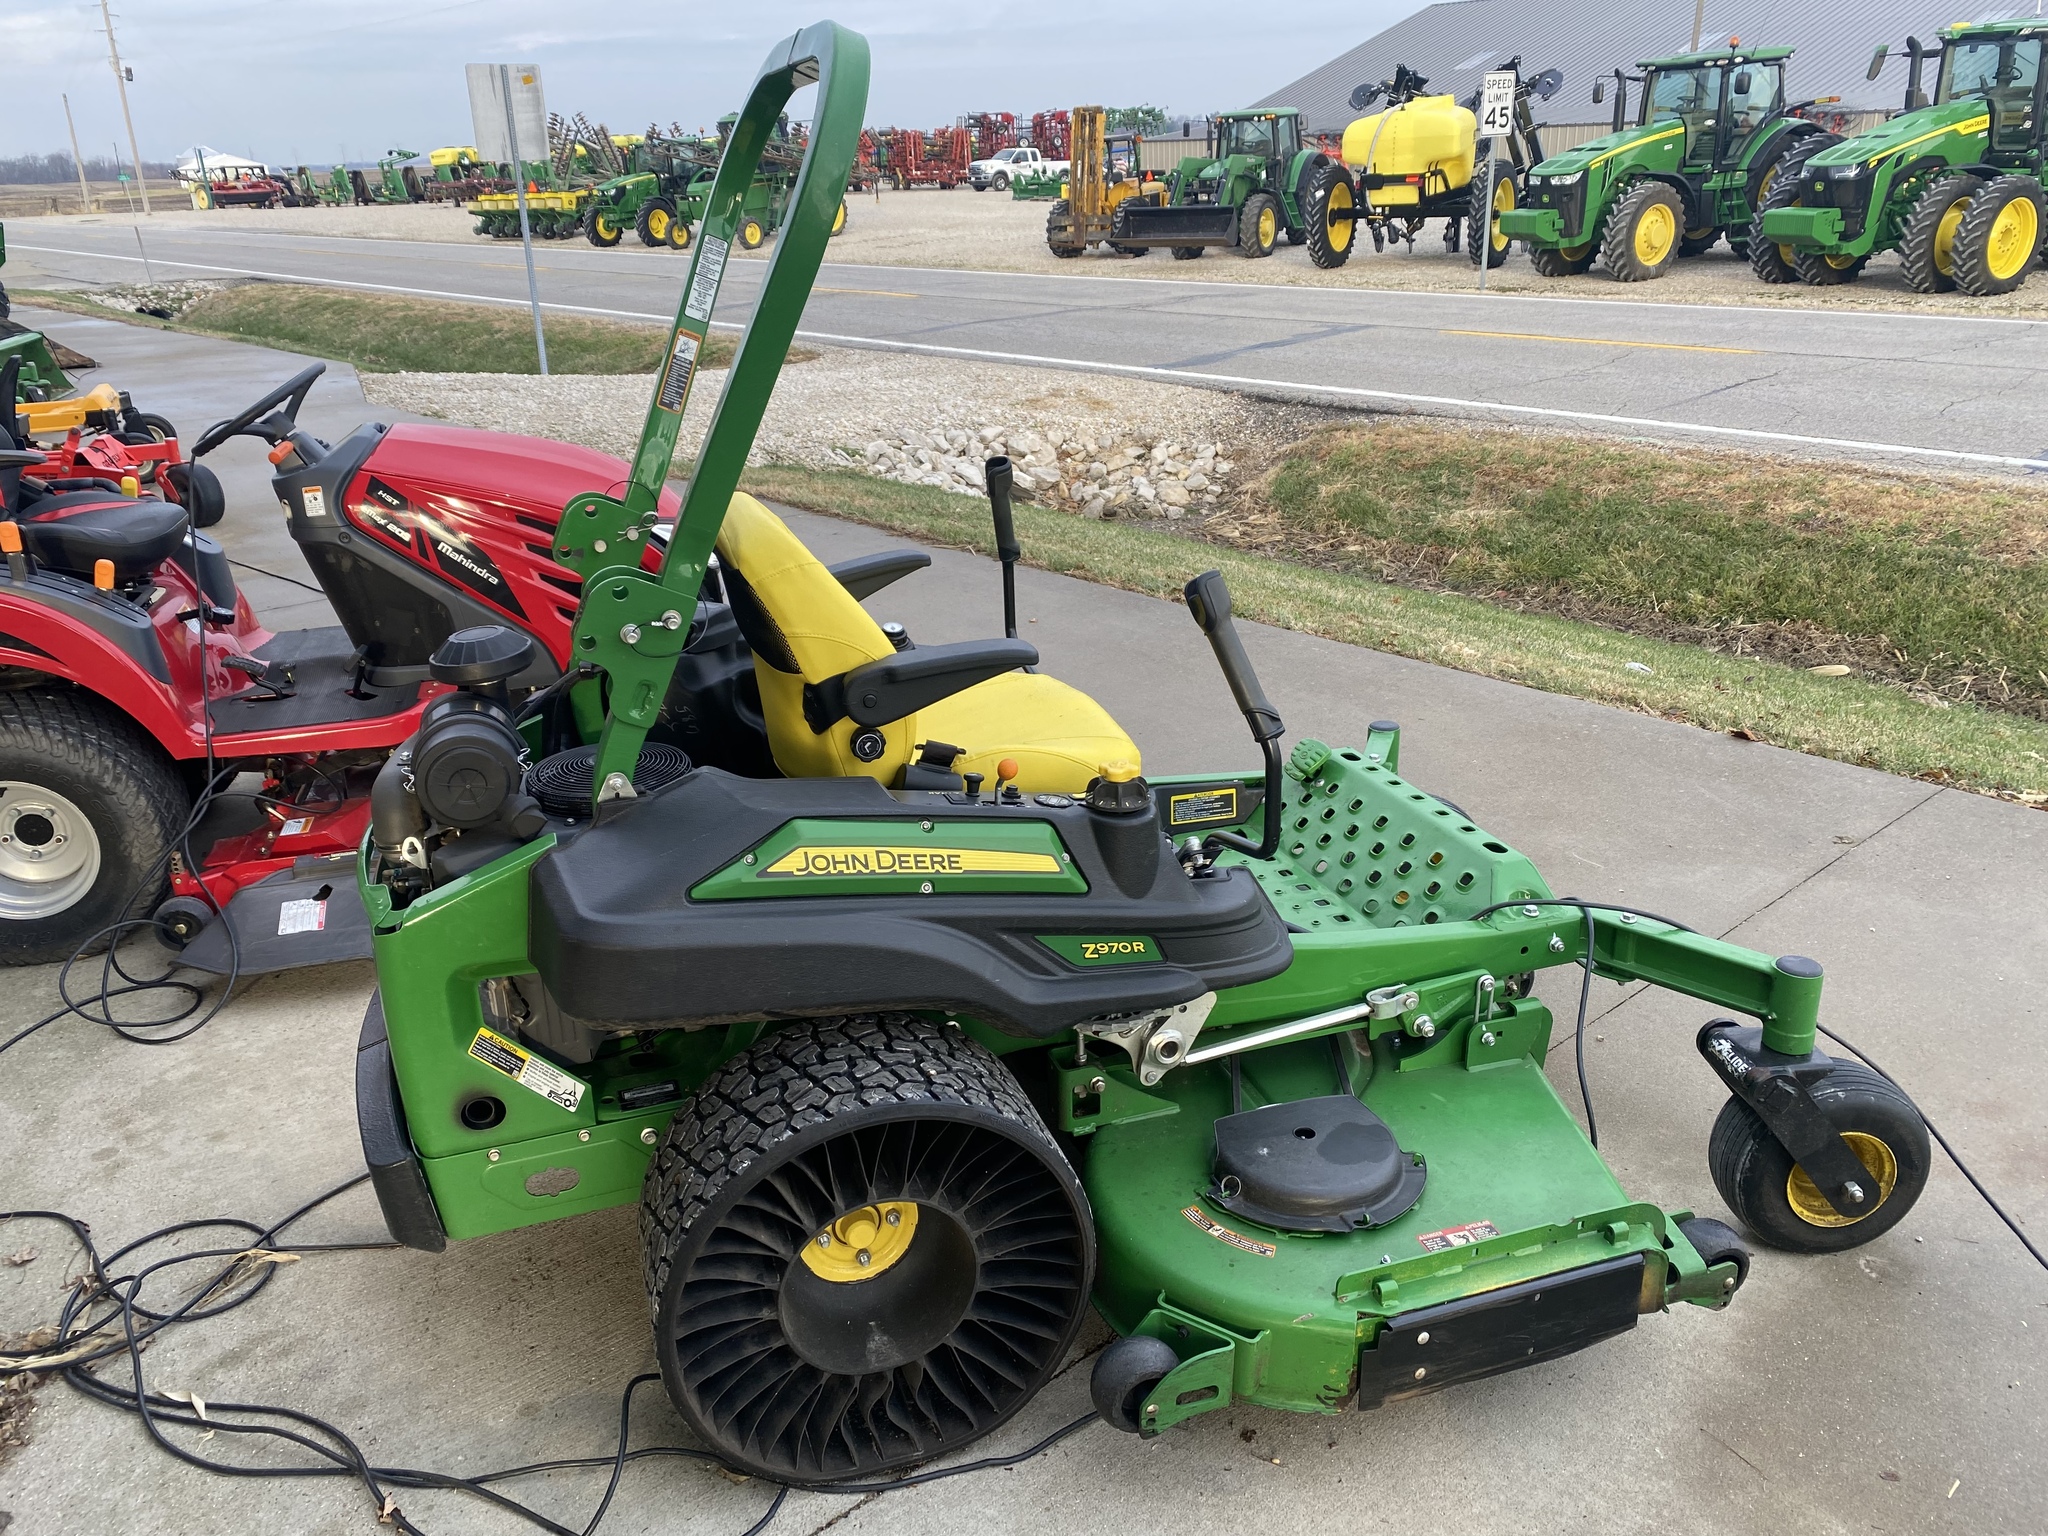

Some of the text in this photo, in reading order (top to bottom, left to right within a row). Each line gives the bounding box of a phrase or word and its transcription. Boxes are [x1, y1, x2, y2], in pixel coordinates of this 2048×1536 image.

[1486, 79, 1512, 90] SPEED
[1488, 92, 1509, 103] LIMIT
[1484, 106, 1509, 129] 45
[377, 489, 400, 507] HST
[437, 541, 499, 586] Mahindra
[796, 849, 963, 872] JOHN DEERE
[1081, 941, 1146, 959] Z970R
[494, 1036, 518, 1055] CAUTION
